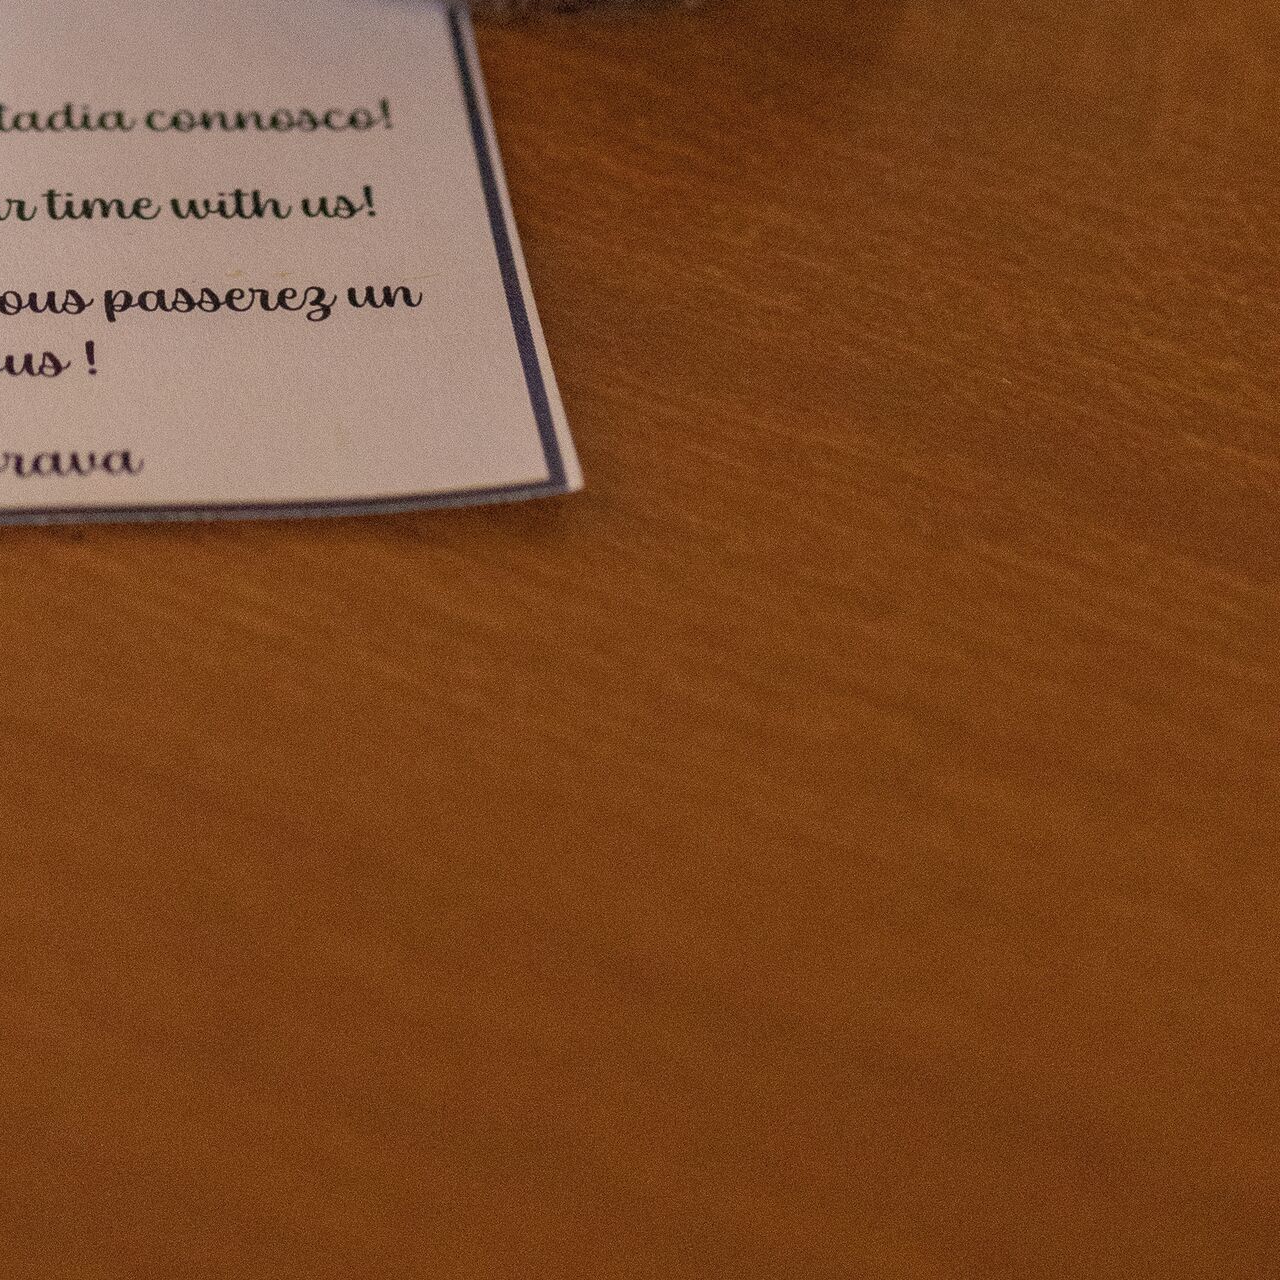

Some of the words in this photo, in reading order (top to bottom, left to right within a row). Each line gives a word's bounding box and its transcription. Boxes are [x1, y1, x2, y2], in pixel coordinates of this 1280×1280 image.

[143, 98, 393, 133] connosco!
[42, 188, 161, 221] time
[169, 188, 292, 220] with
[300, 184, 377, 220] us!
[103, 285, 338, 323] passerez
[346, 285, 424, 310] un
[84, 340, 98, 376] !
